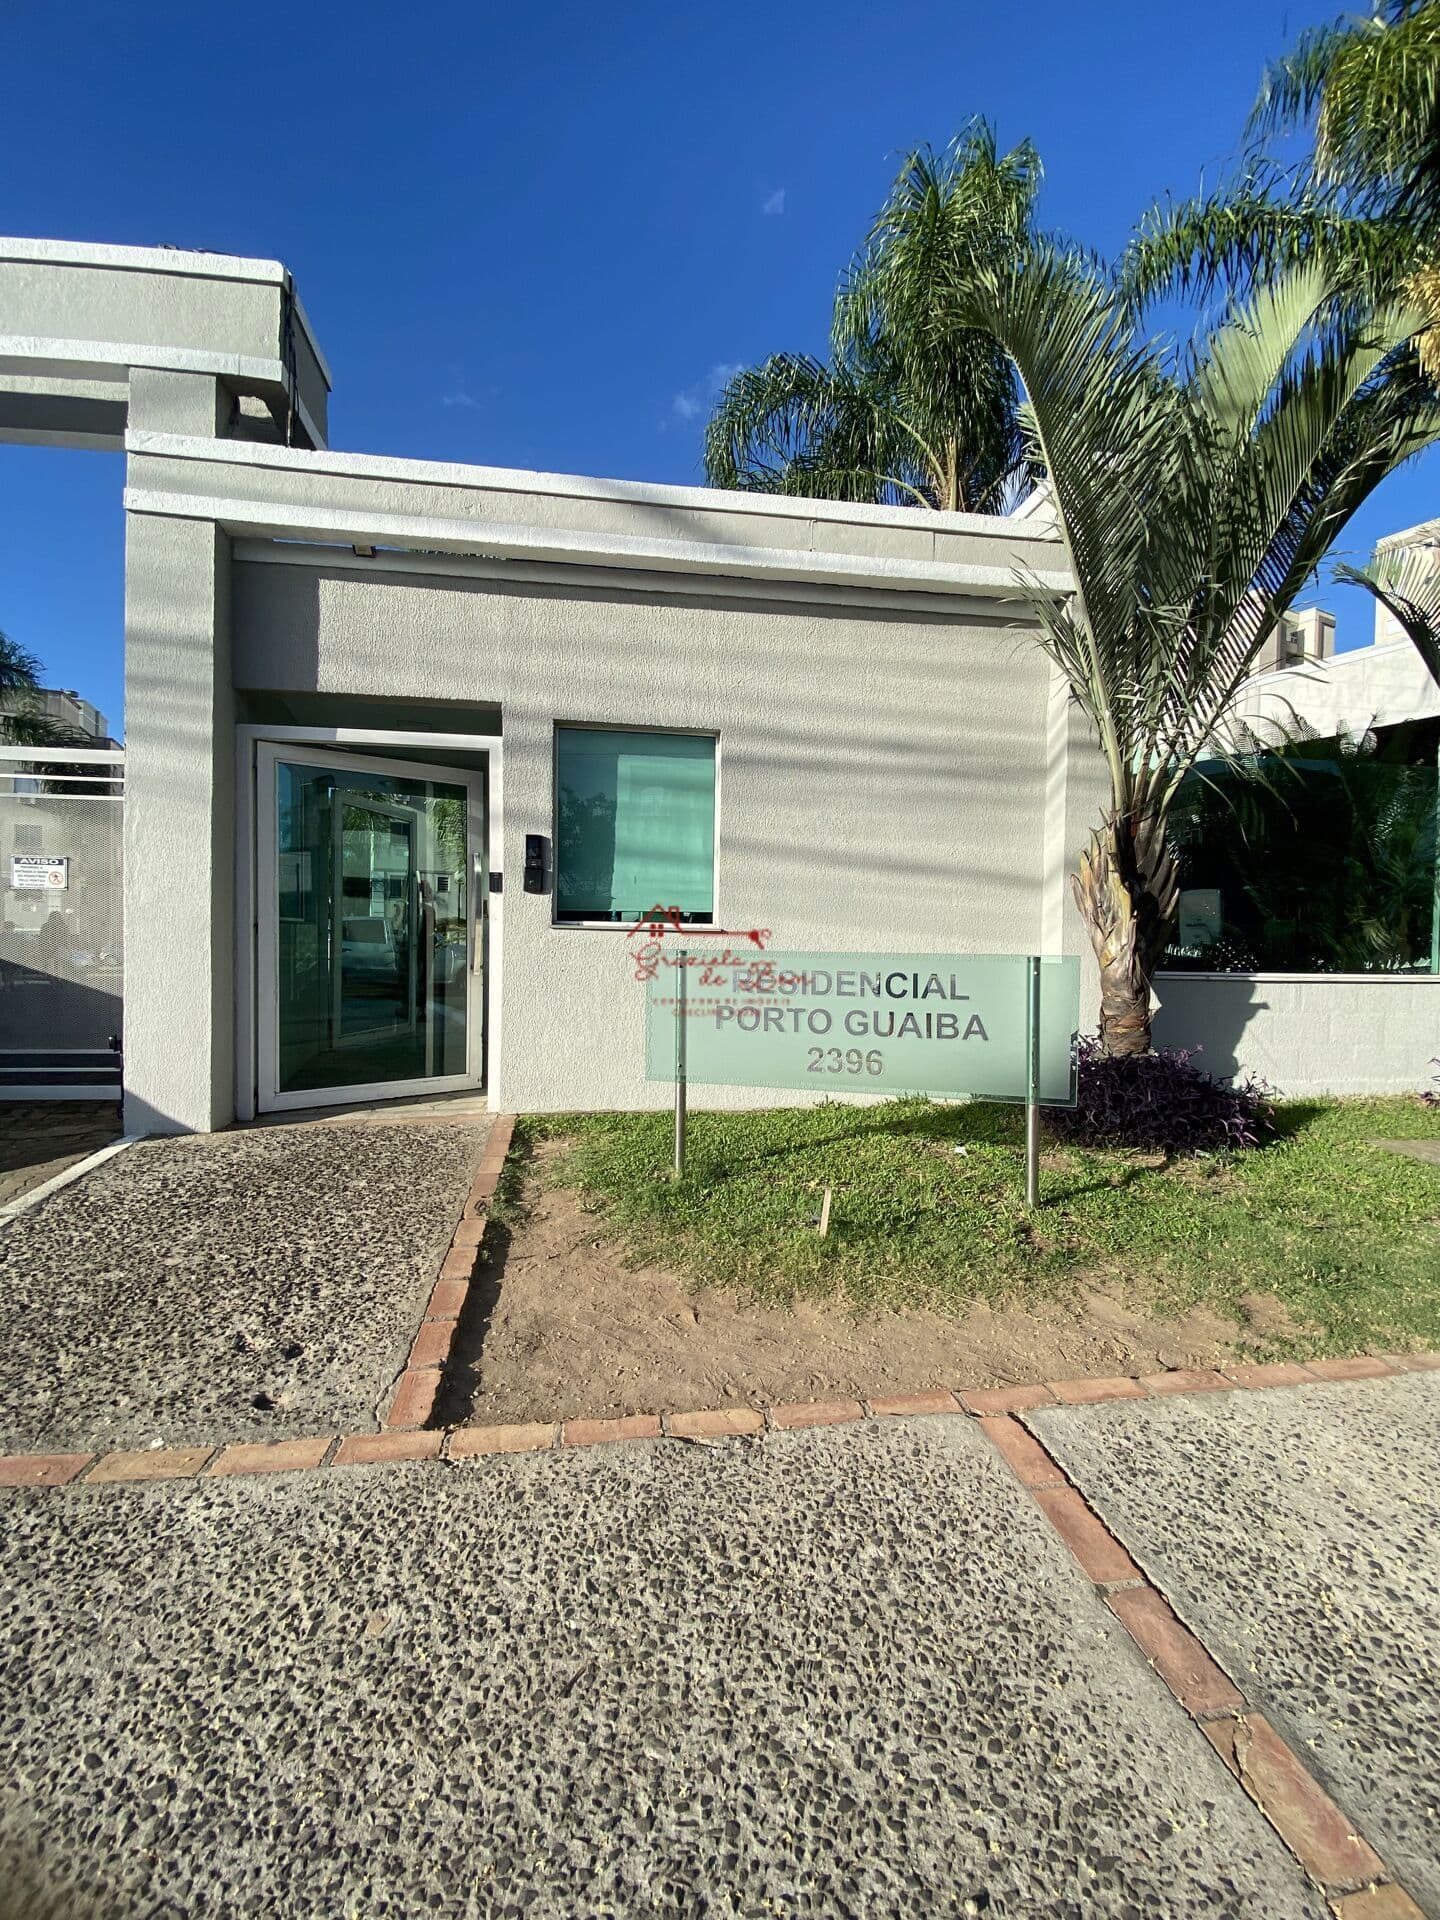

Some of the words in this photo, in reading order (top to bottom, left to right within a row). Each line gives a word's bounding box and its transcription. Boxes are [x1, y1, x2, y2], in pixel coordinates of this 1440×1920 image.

[731, 970, 970, 1000] RESIDENCIAL
[715, 1005, 832, 1035] PORTO
[844, 1010, 989, 1041] GUAIBA
[806, 1047, 884, 1075] 2396
